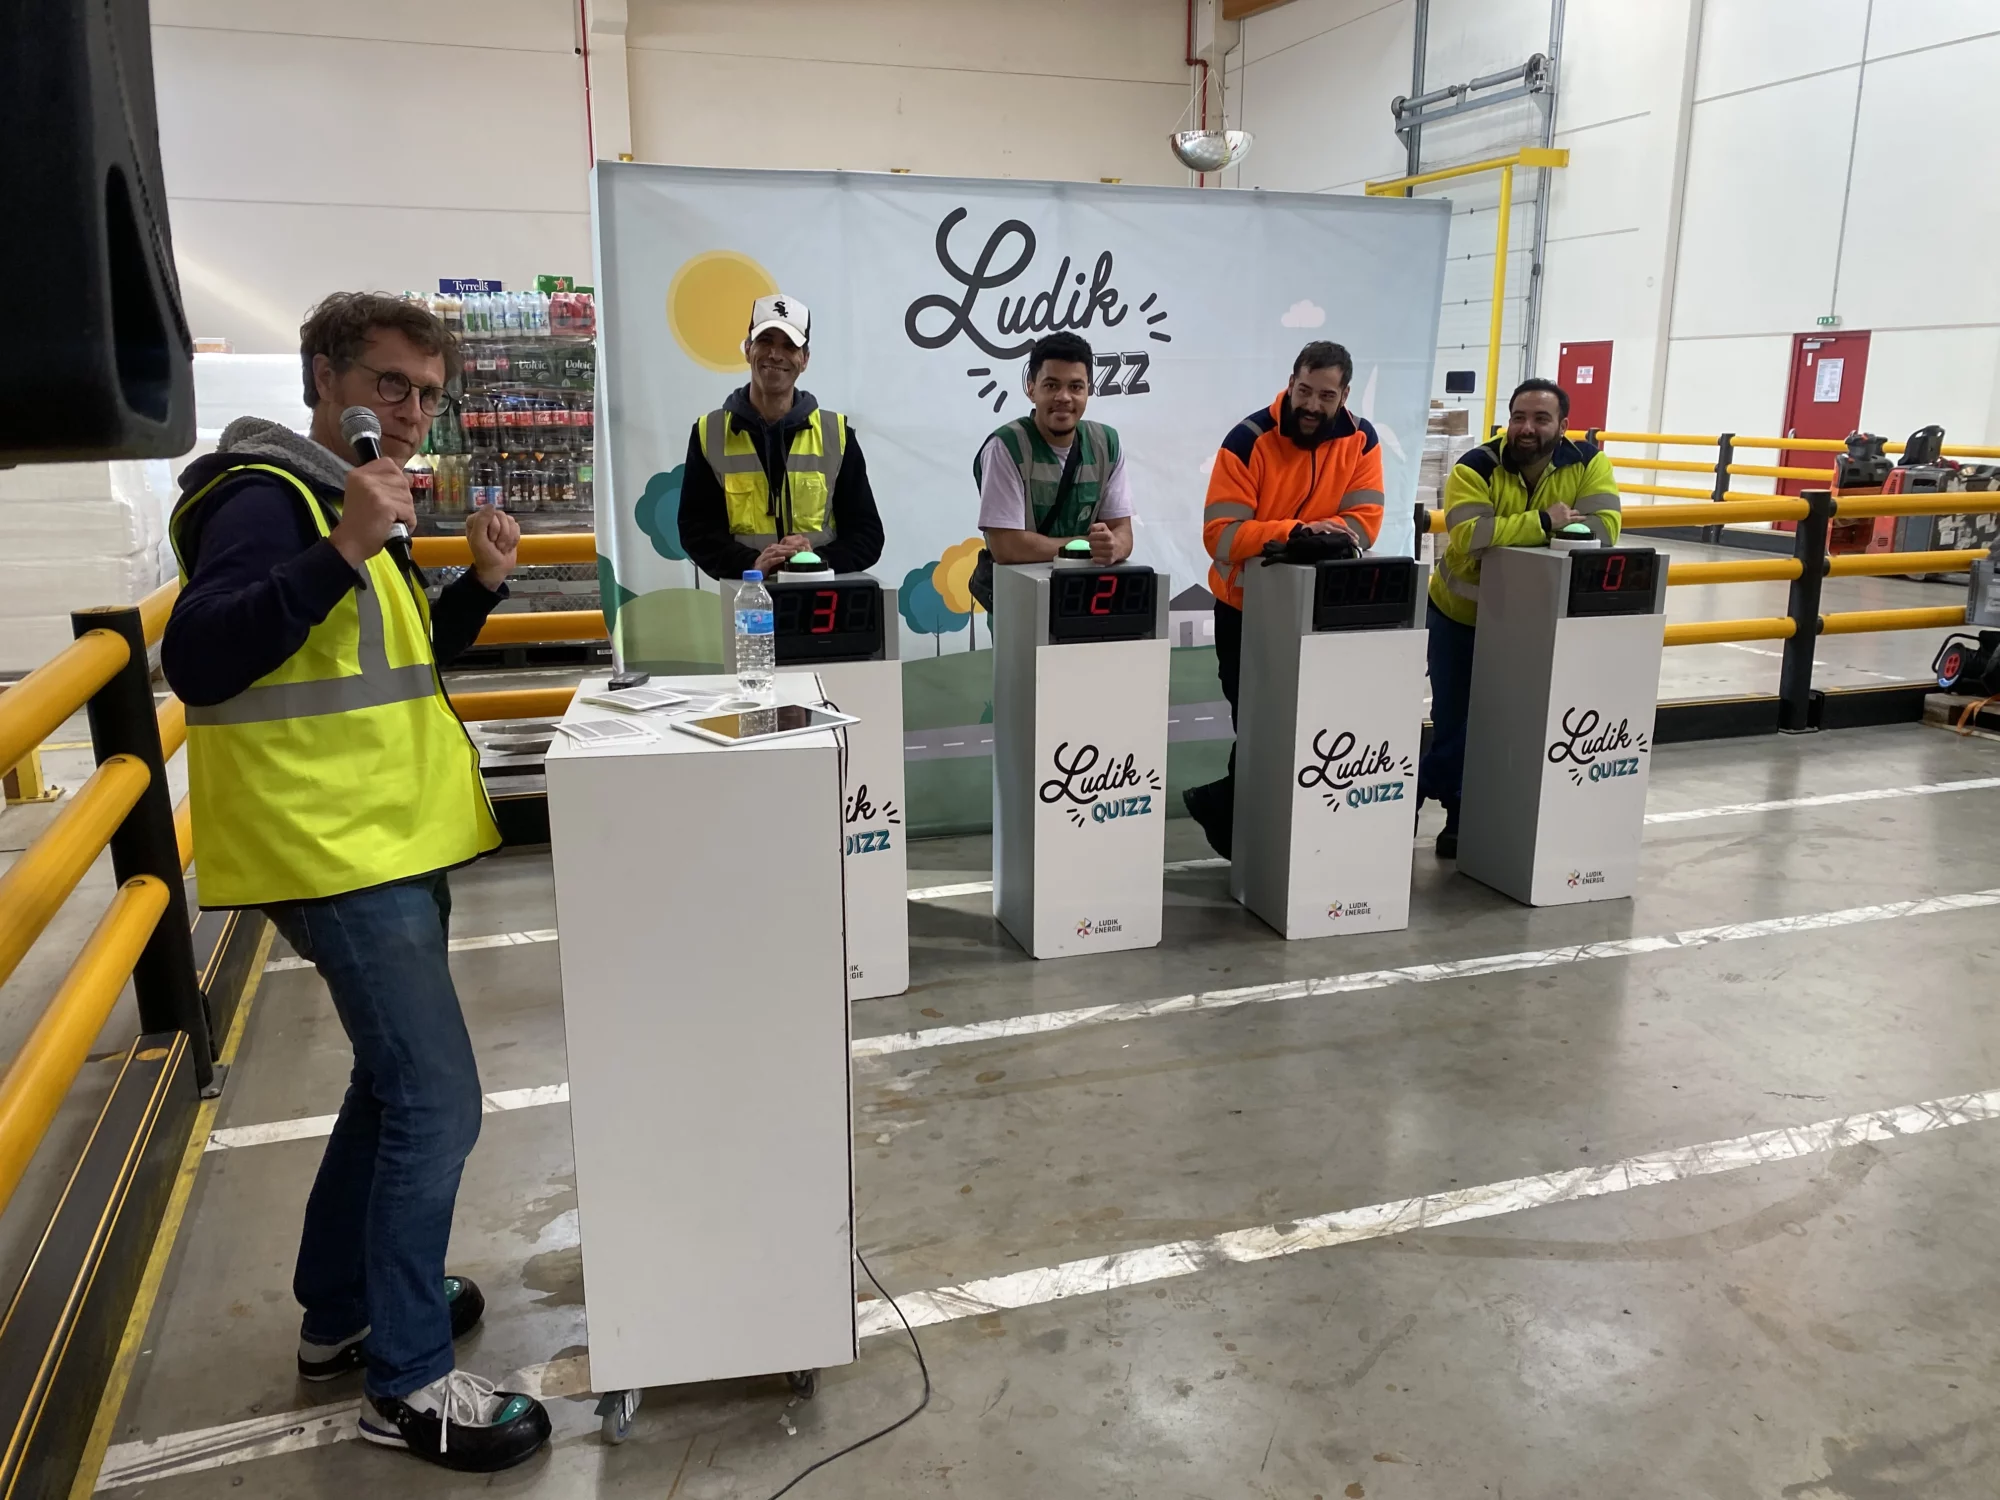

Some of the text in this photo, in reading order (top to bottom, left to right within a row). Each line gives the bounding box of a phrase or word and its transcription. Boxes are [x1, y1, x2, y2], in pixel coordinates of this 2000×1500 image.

[905, 207, 1128, 360] Ludik
[1602, 555, 1626, 591] 0
[810, 590, 838, 633] 3
[1090, 575, 1118, 615] 2
[1547, 706, 1632, 765] Ludik
[1039, 742, 1141, 805] Ludik
[1298, 728, 1395, 790] Ludik
[1588, 757, 1639, 783] QUIZZ
[1091, 795, 1152, 824] QUIZZ
[1346, 781, 1404, 809] QUIZZ
[1585, 870, 1603, 878] LUDIK
[1098, 918, 1119, 927] LUDIK
[1349, 901, 1368, 909] LUDIK
